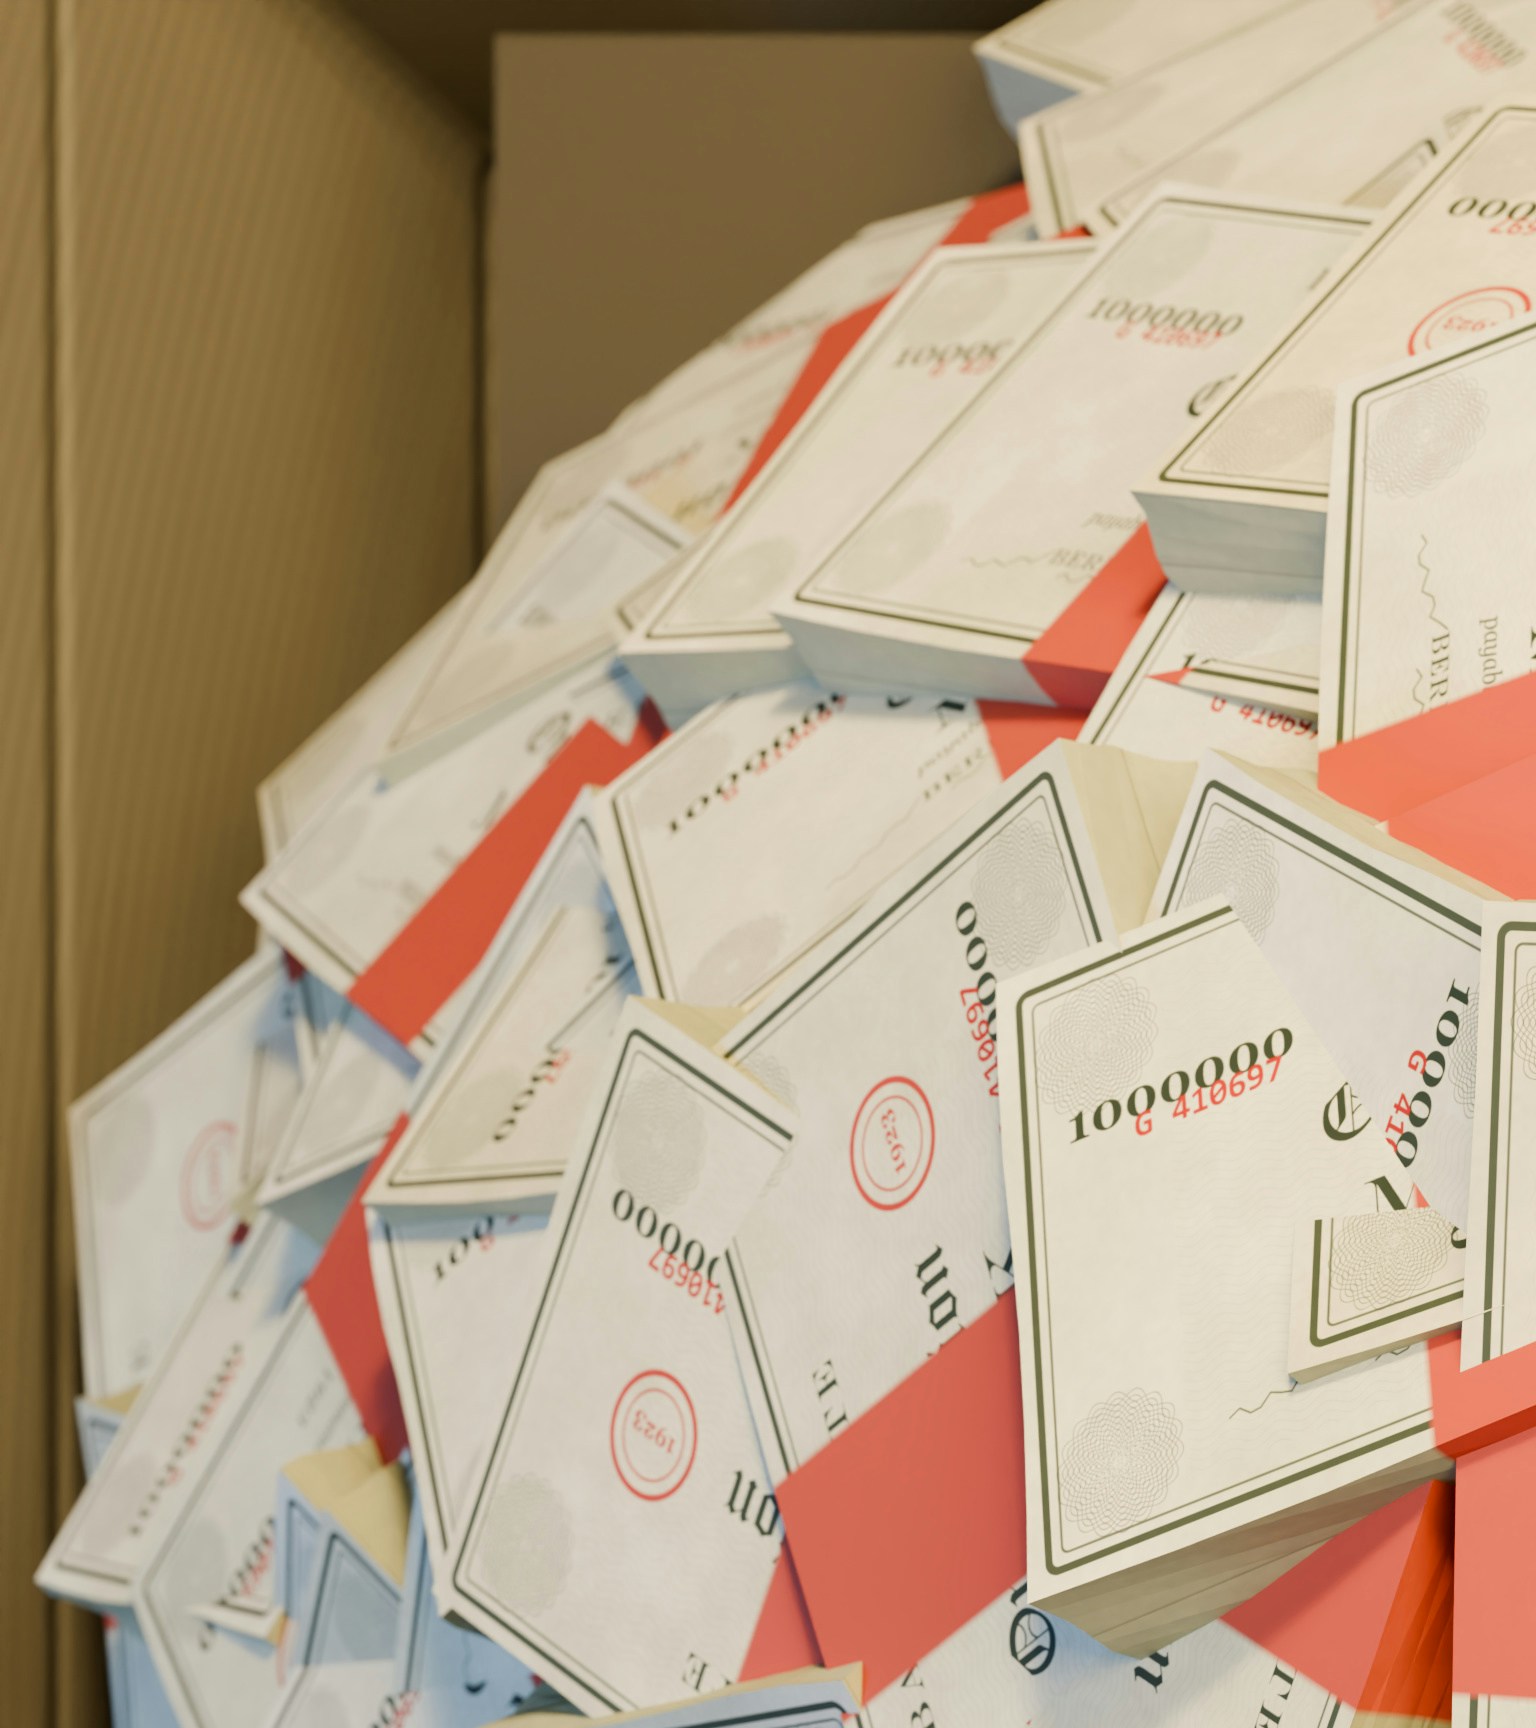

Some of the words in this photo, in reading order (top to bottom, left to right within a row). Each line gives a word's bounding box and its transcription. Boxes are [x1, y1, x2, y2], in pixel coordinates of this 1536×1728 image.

[1478, 615, 1505, 687] payab
[1069, 1026, 1294, 1144] 1000000
[1134, 1107, 1154, 1138] G
[1171, 1054, 1283, 1120] 410697
